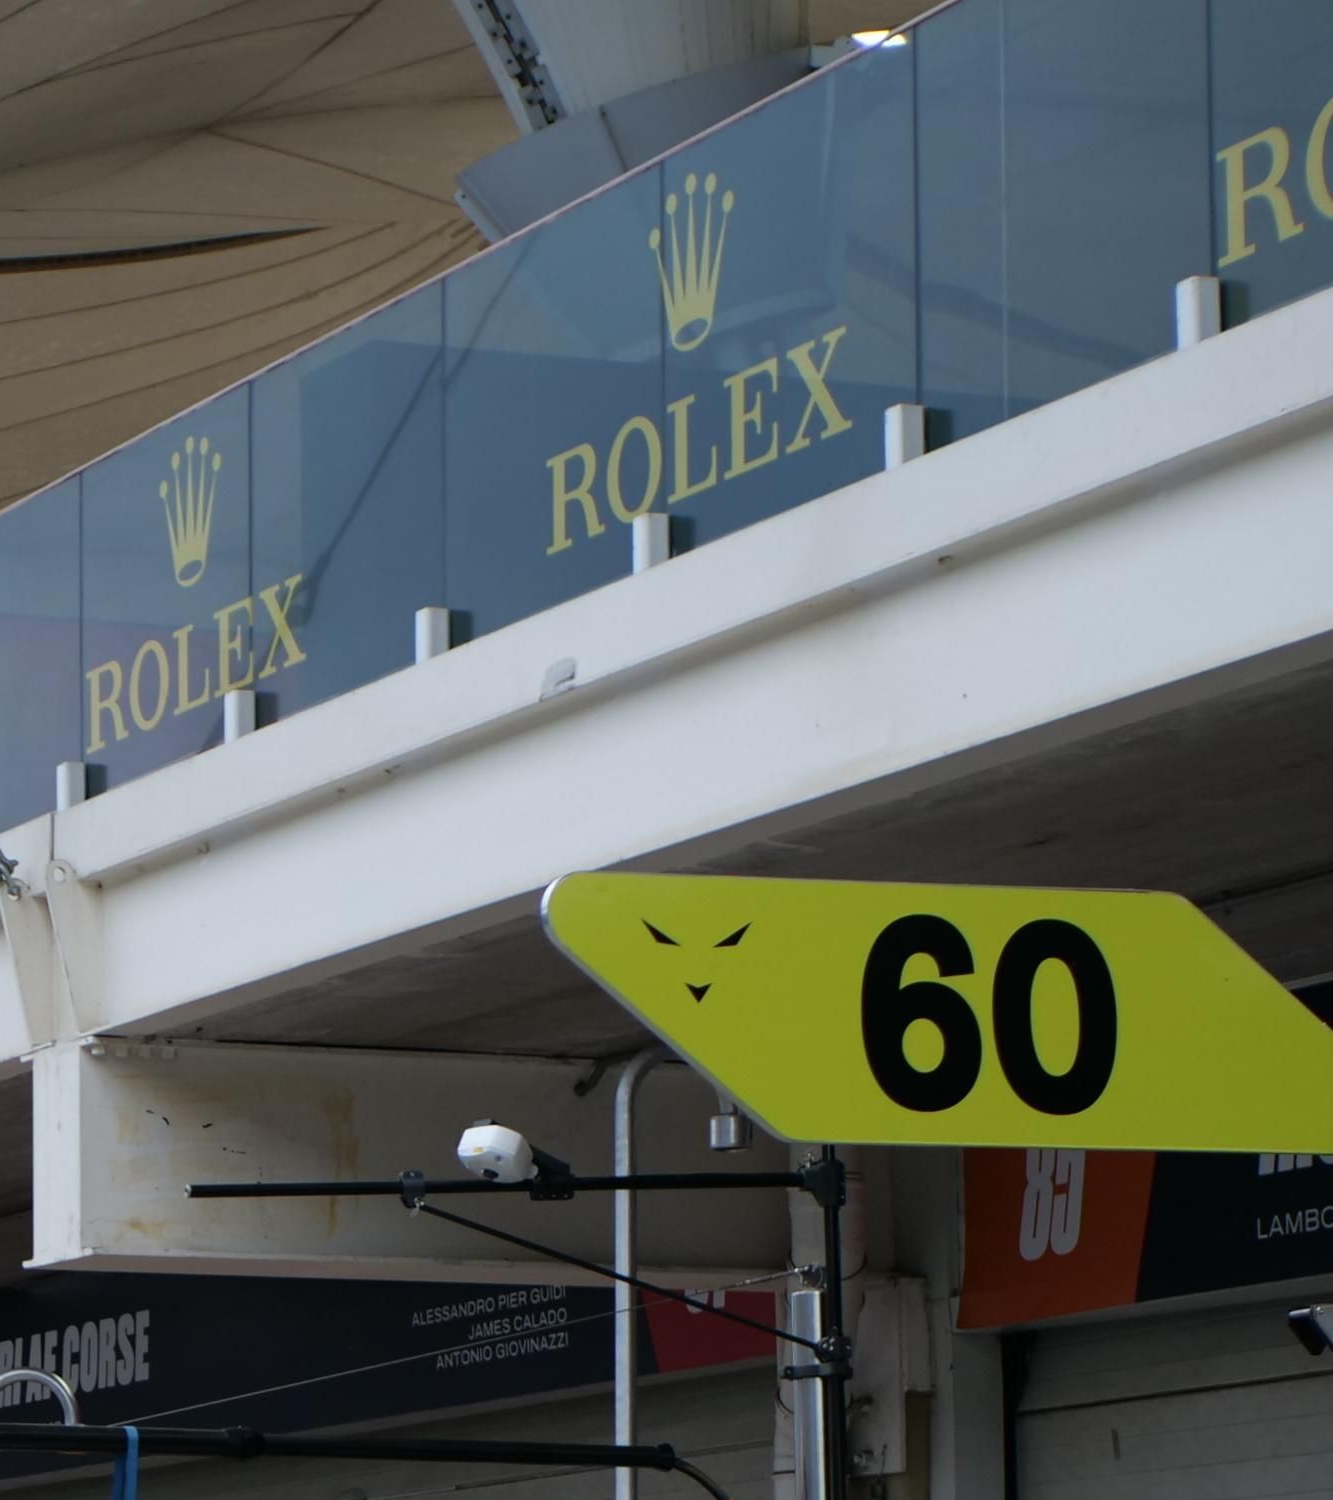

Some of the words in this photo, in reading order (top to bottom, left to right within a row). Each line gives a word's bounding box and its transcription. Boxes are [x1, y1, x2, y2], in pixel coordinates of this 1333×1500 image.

[546, 325, 853, 556] ROLEX
[85, 574, 307, 753] ROLEX
[861, 913, 1117, 1116] 60
[411, 1297, 496, 1328] ALESSANDRO
[497, 1290, 528, 1313] PIER
[529, 1284, 567, 1306] GUIDI
[434, 1344, 493, 1370] ANTONIO
[495, 1331, 570, 1360] GIOVINAZZI
[467, 1317, 512, 1341] JAMES
[513, 1307, 568, 1332] CALADO
[25, 1329, 59, 1404] AF
[61, 1309, 151, 1398] CORSE
